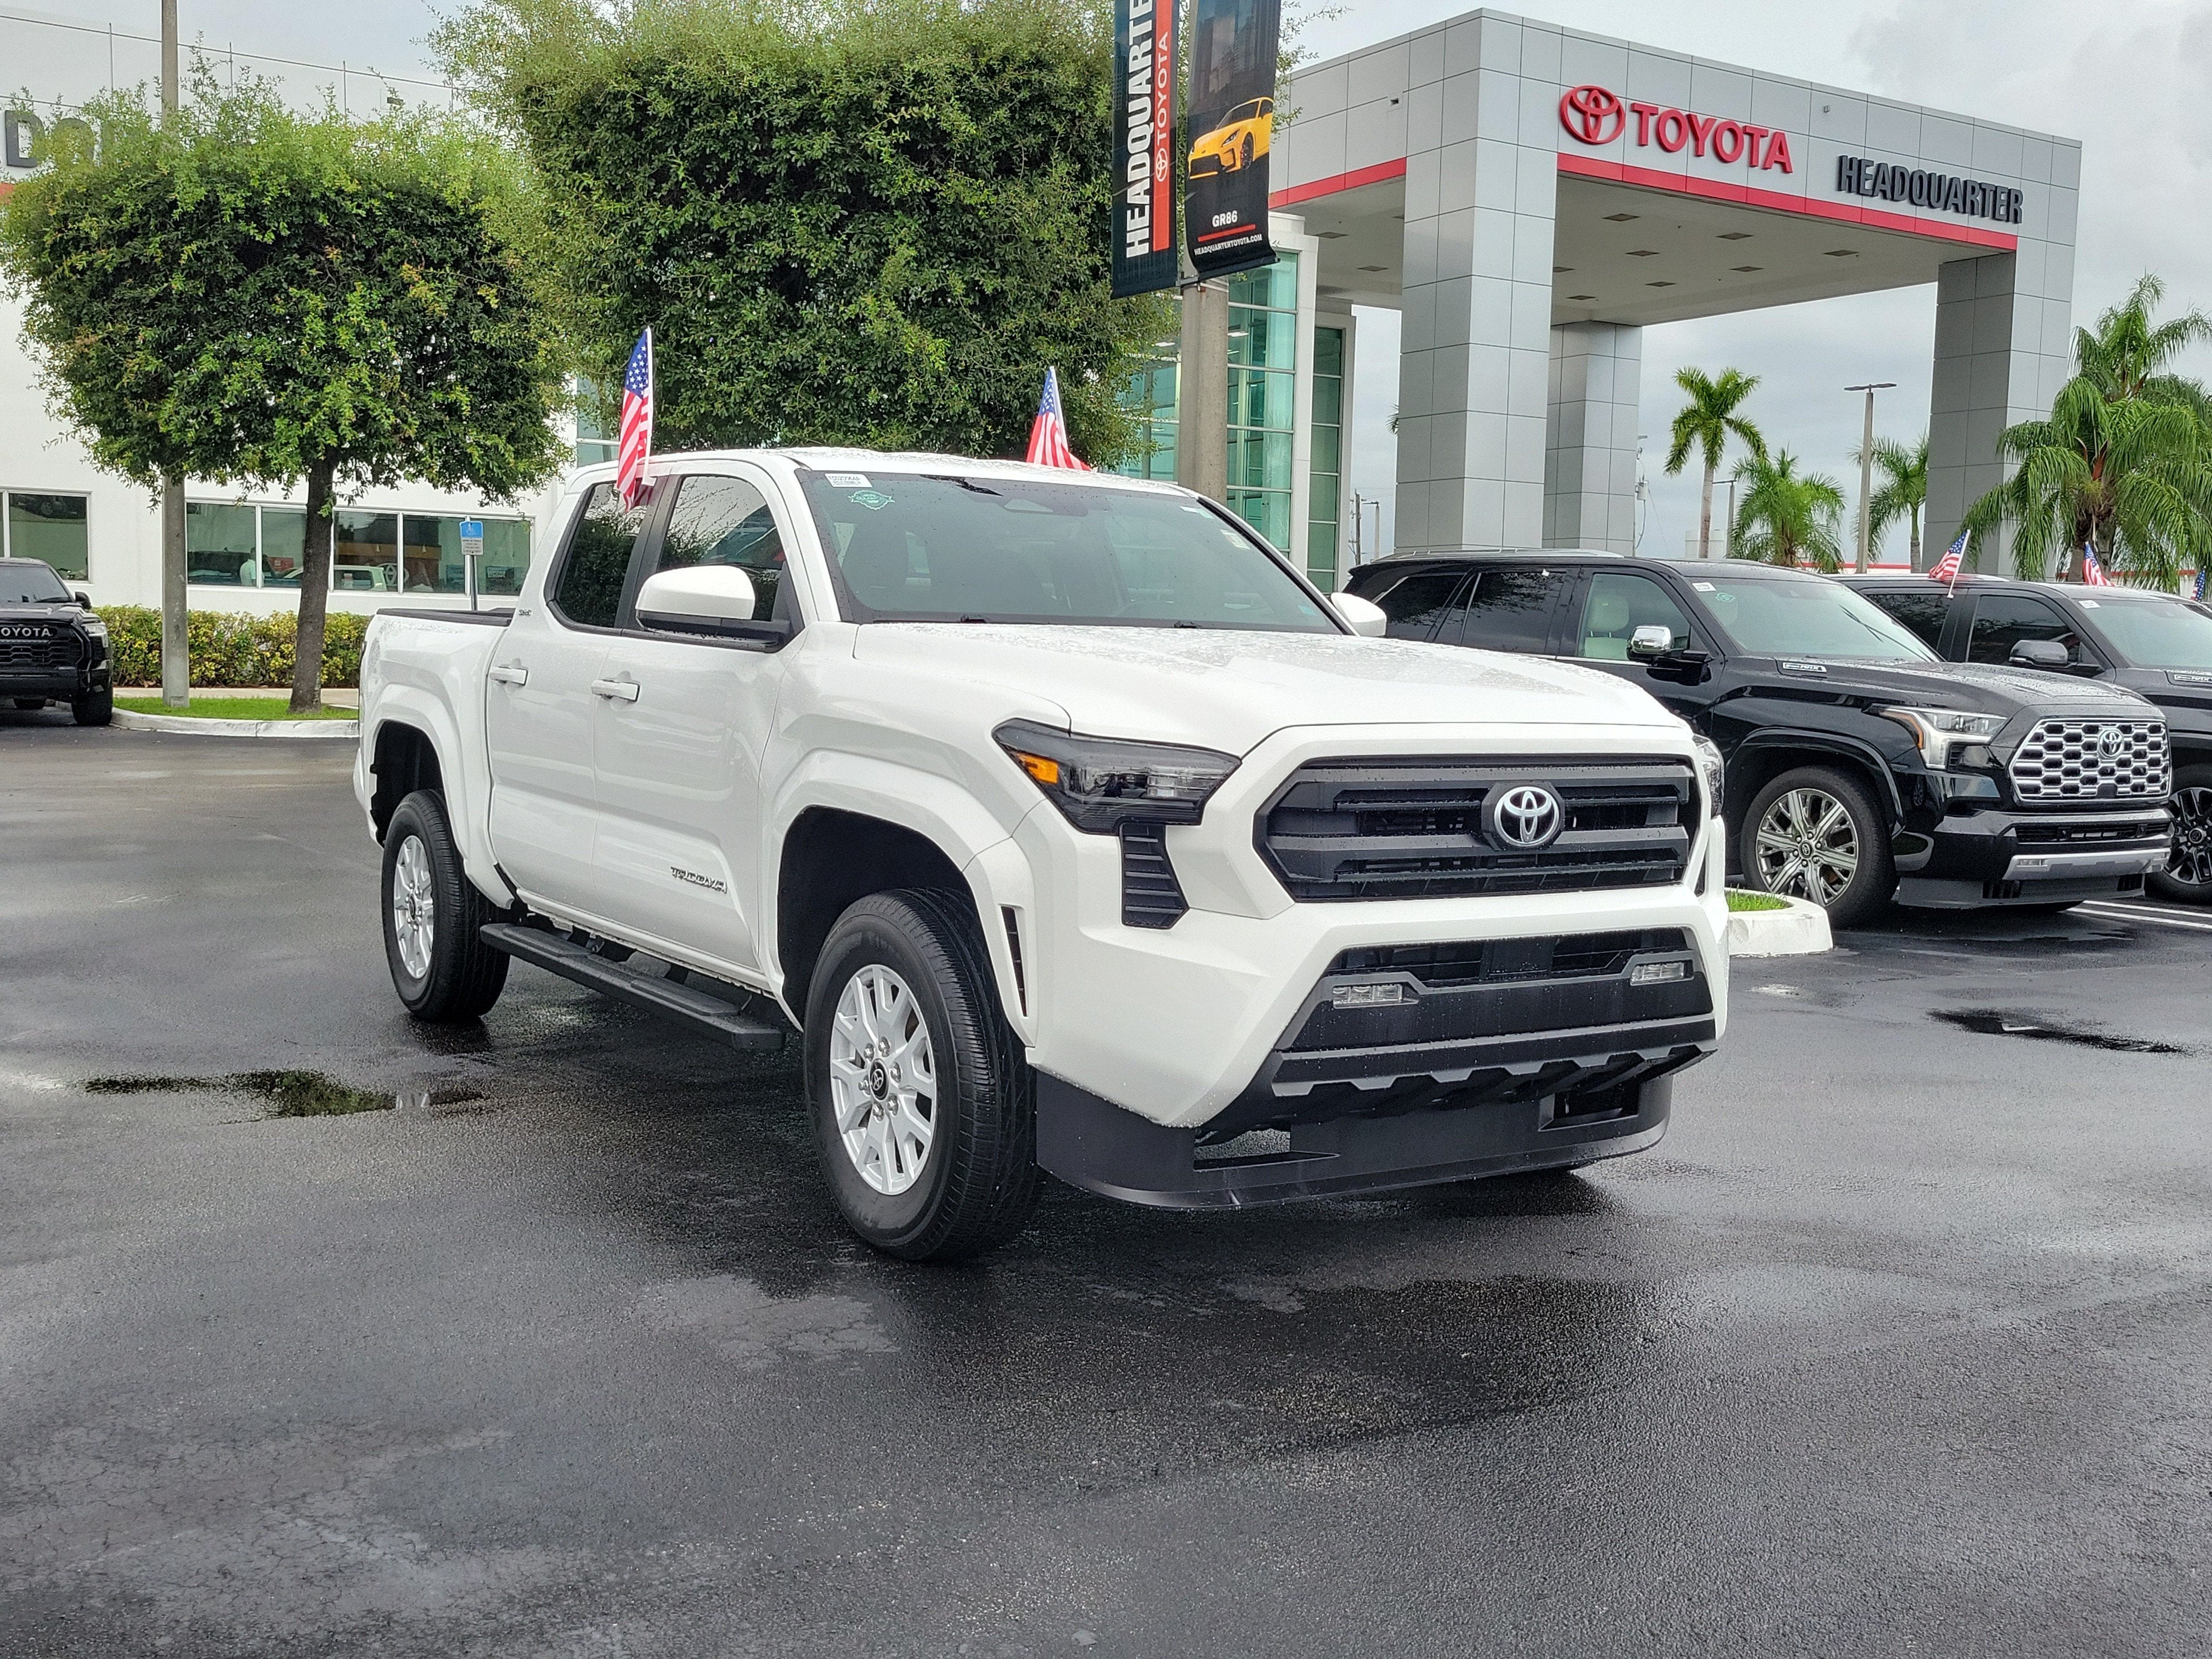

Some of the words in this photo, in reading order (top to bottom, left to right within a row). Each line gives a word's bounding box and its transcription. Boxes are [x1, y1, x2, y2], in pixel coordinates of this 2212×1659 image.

[1157, 31, 1169, 146] TOYOTA
[1631, 102, 1793, 174] TOYOTA
[1212, 210, 1238, 228] GR86
[1837, 155, 2023, 224] HEADQUARTER
[1194, 233, 1263, 256] HEADQUARTERTOYOTA.COM
